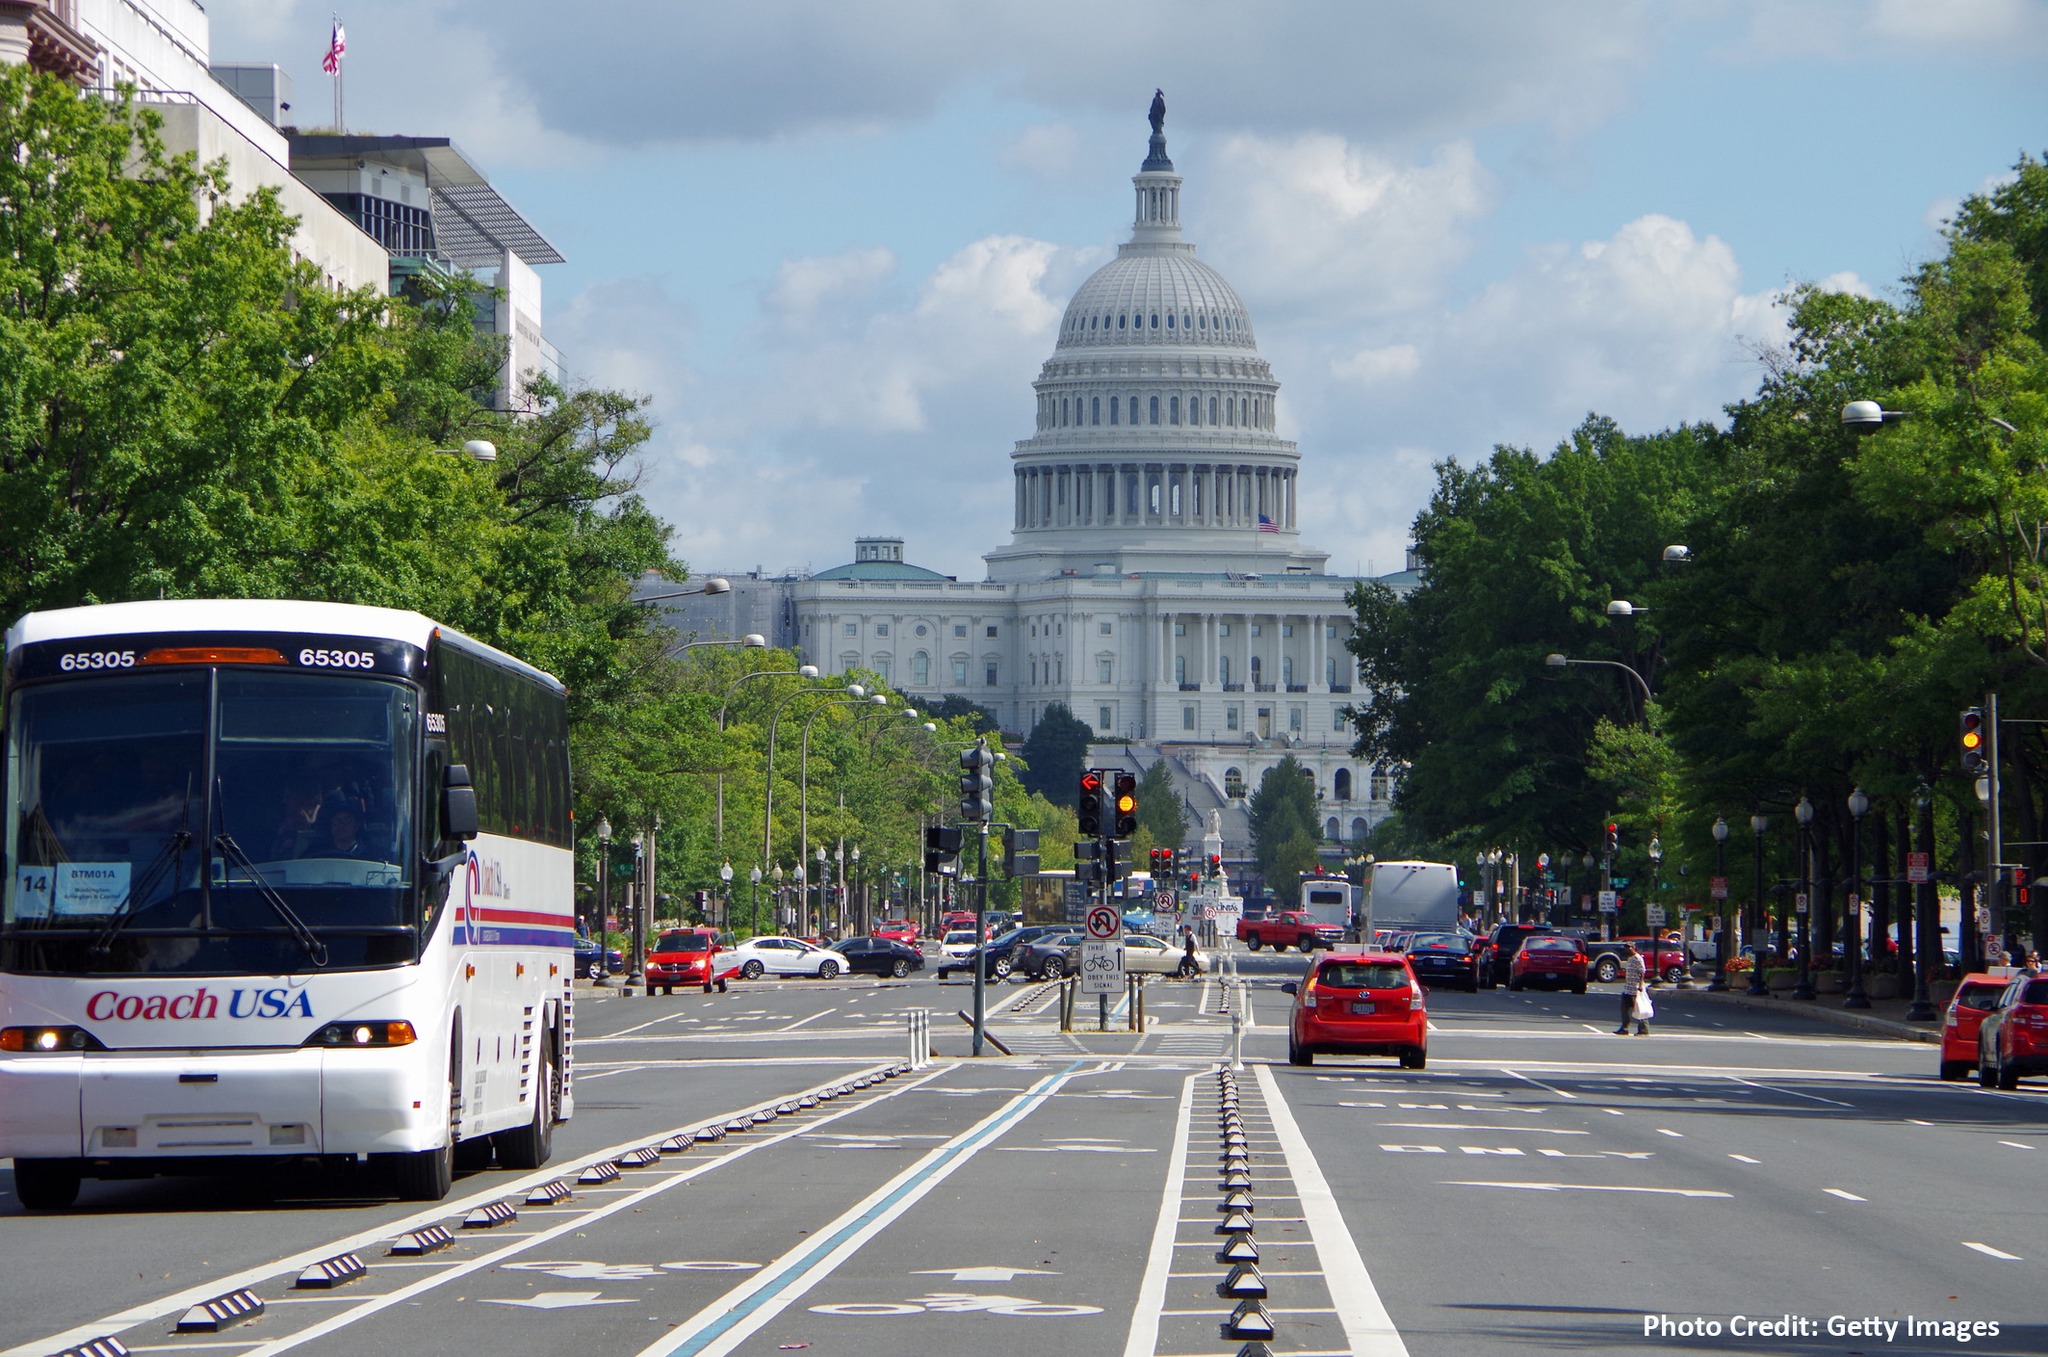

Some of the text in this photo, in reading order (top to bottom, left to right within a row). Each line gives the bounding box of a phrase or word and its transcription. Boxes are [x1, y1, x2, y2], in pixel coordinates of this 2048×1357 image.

[60, 650, 135, 671] 65305
[299, 649, 375, 669] 65305
[426, 712, 446, 733] 65305
[23, 875, 47, 893] 14
[71, 869, 116, 879] BTM01A
[86, 987, 314, 1020] Coach USA
